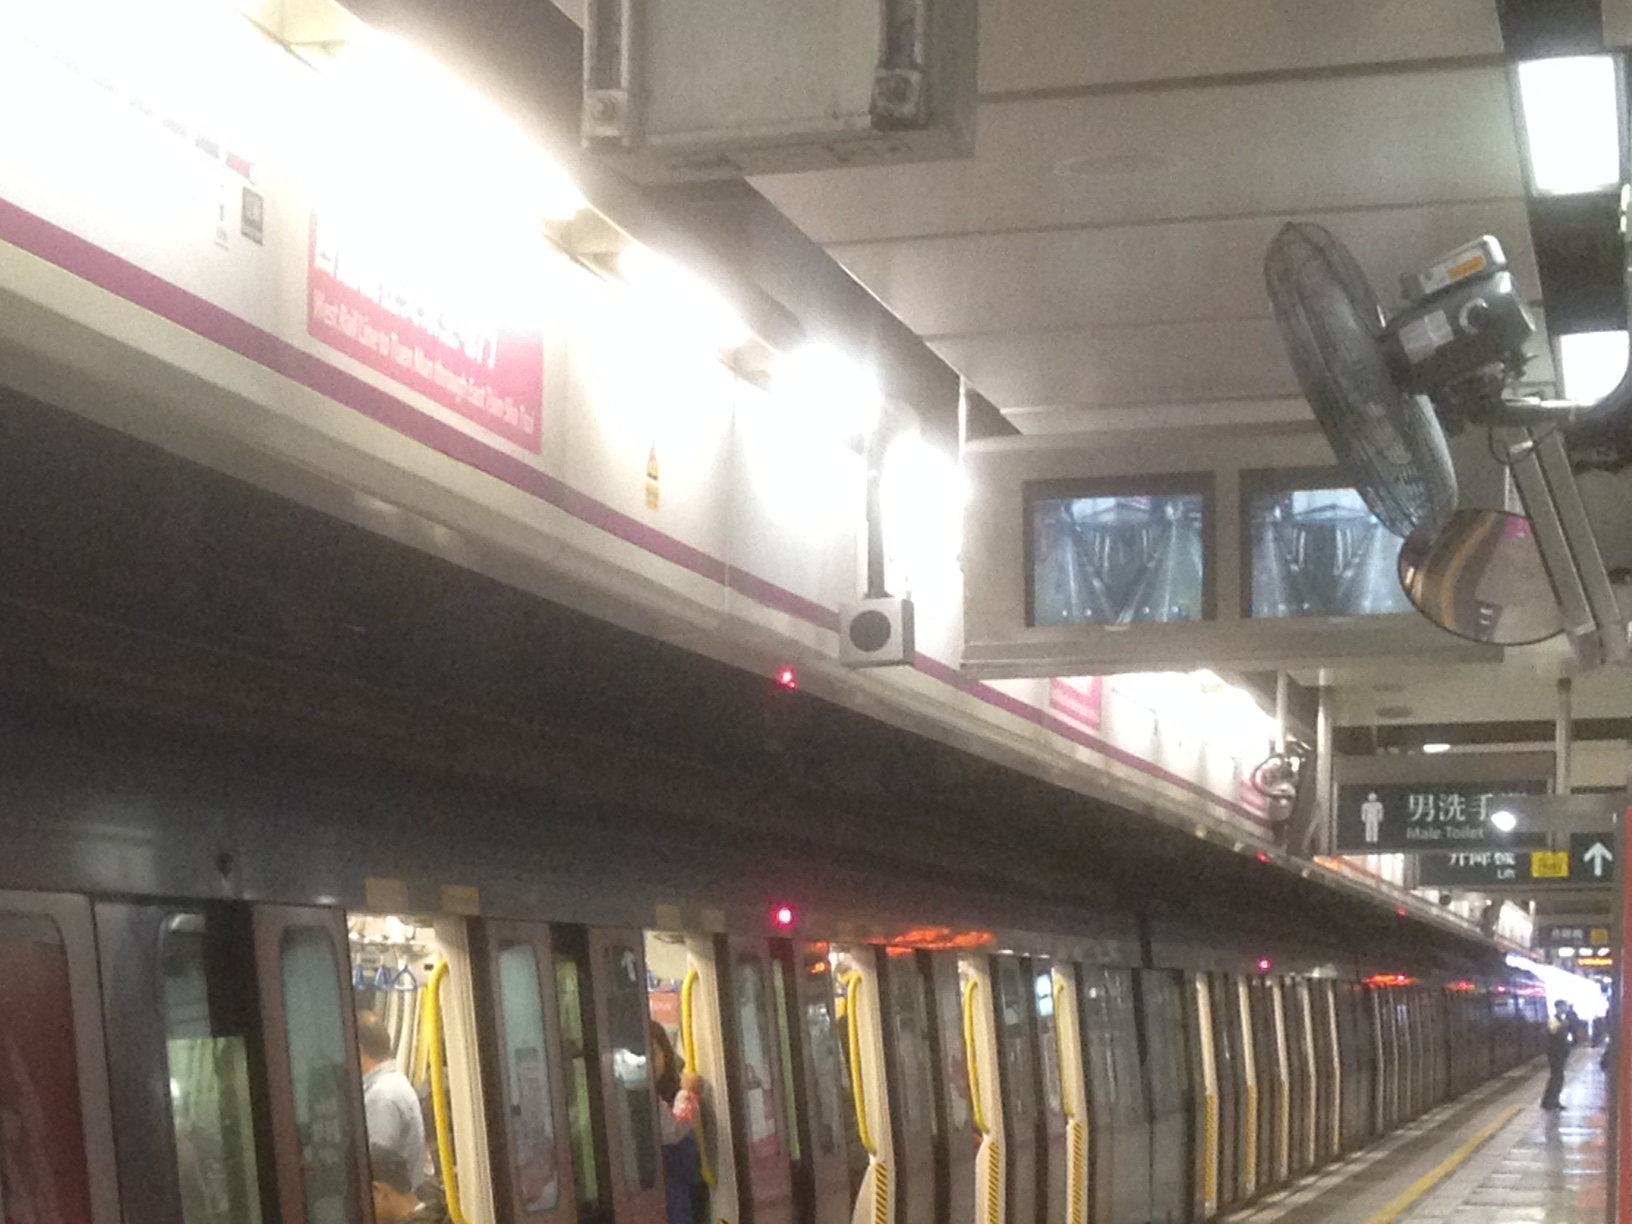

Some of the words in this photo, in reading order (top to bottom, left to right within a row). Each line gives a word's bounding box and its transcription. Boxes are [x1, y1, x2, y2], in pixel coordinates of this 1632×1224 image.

[1407, 826, 1440, 839] Male
[1446, 826, 1484, 839] Toilet
[1497, 868, 1516, 879] Lift
